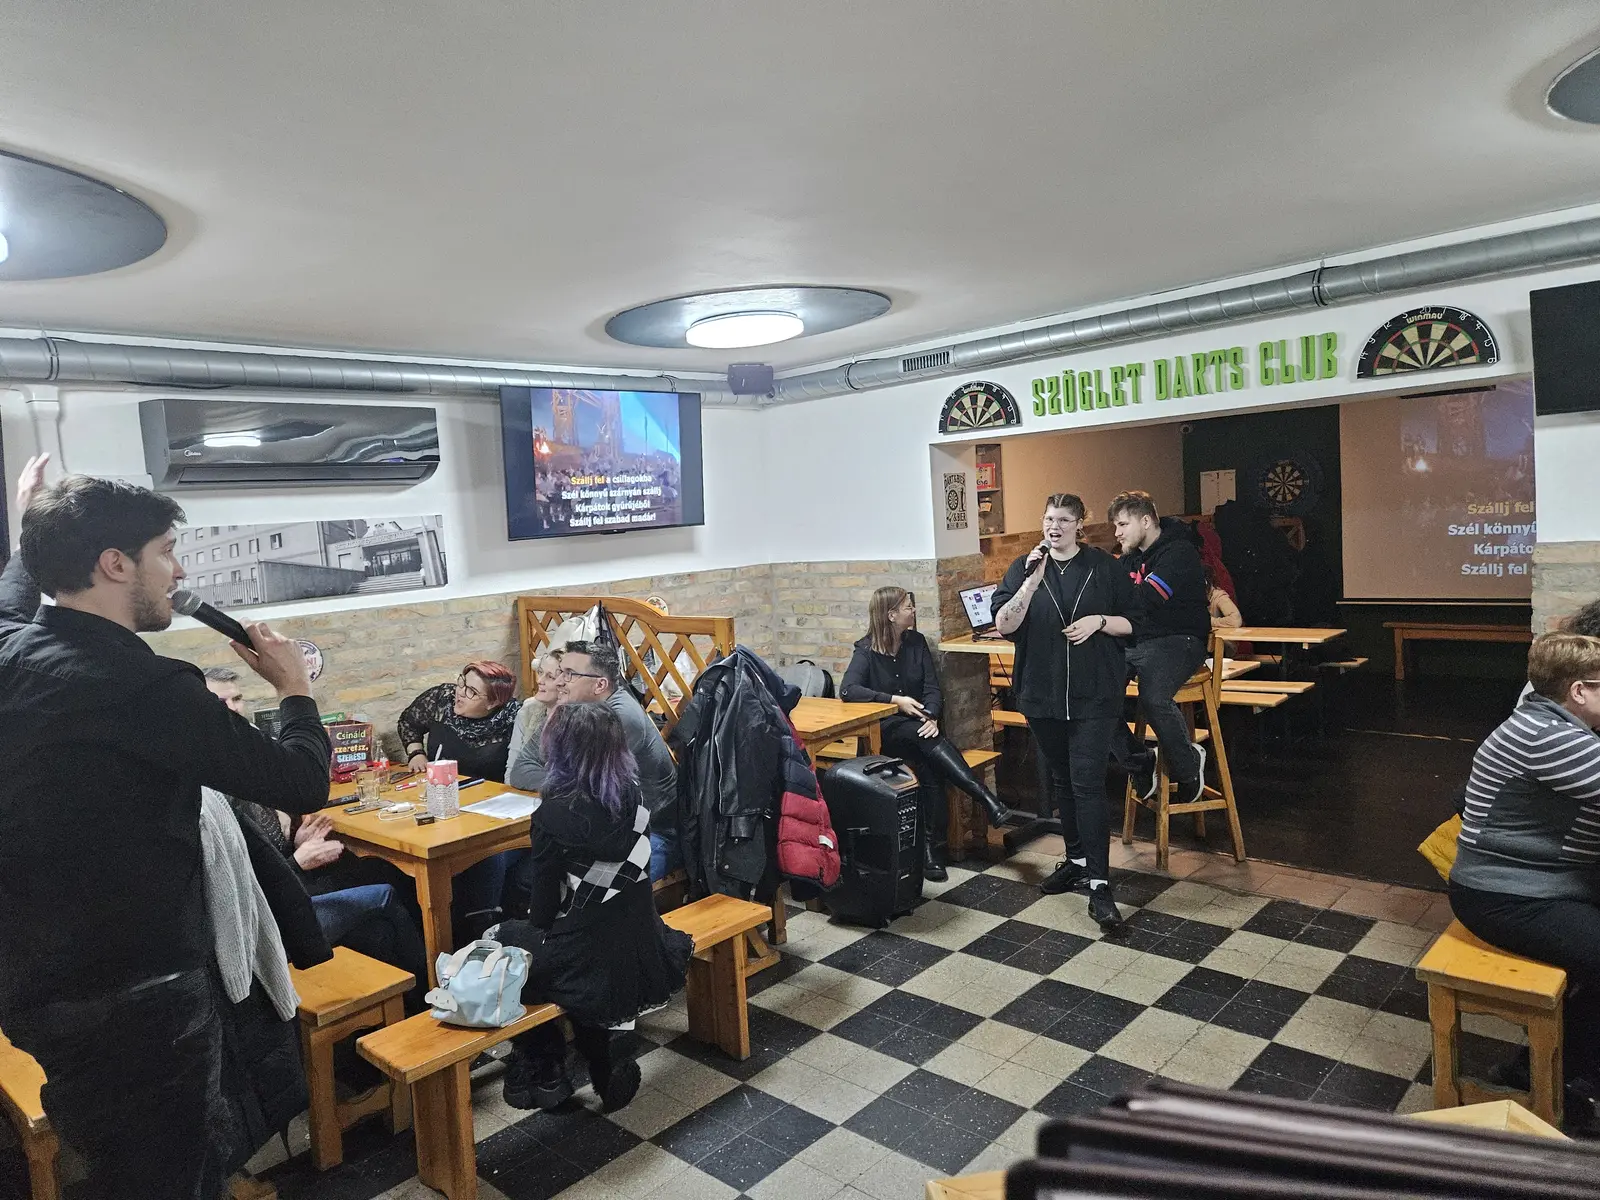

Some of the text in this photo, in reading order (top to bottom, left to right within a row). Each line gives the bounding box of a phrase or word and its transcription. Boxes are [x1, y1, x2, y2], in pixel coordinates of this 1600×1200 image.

[1031, 331, 1338, 416] SZÖGLET DARTS CLUB
[595, 475, 605, 484] fel
[575, 502, 611, 514] Kárpátok
[1467, 501, 1535, 516] Szállj fel
[569, 516, 592, 528] Szállj
[593, 516, 604, 525] fel
[604, 514, 631, 524] szabad
[1448, 522, 1479, 536] Szél
[1473, 542, 1534, 557] Kárpáto
[1461, 562, 1528, 577] Szállj fel
[336, 729, 366, 740] Csináld
